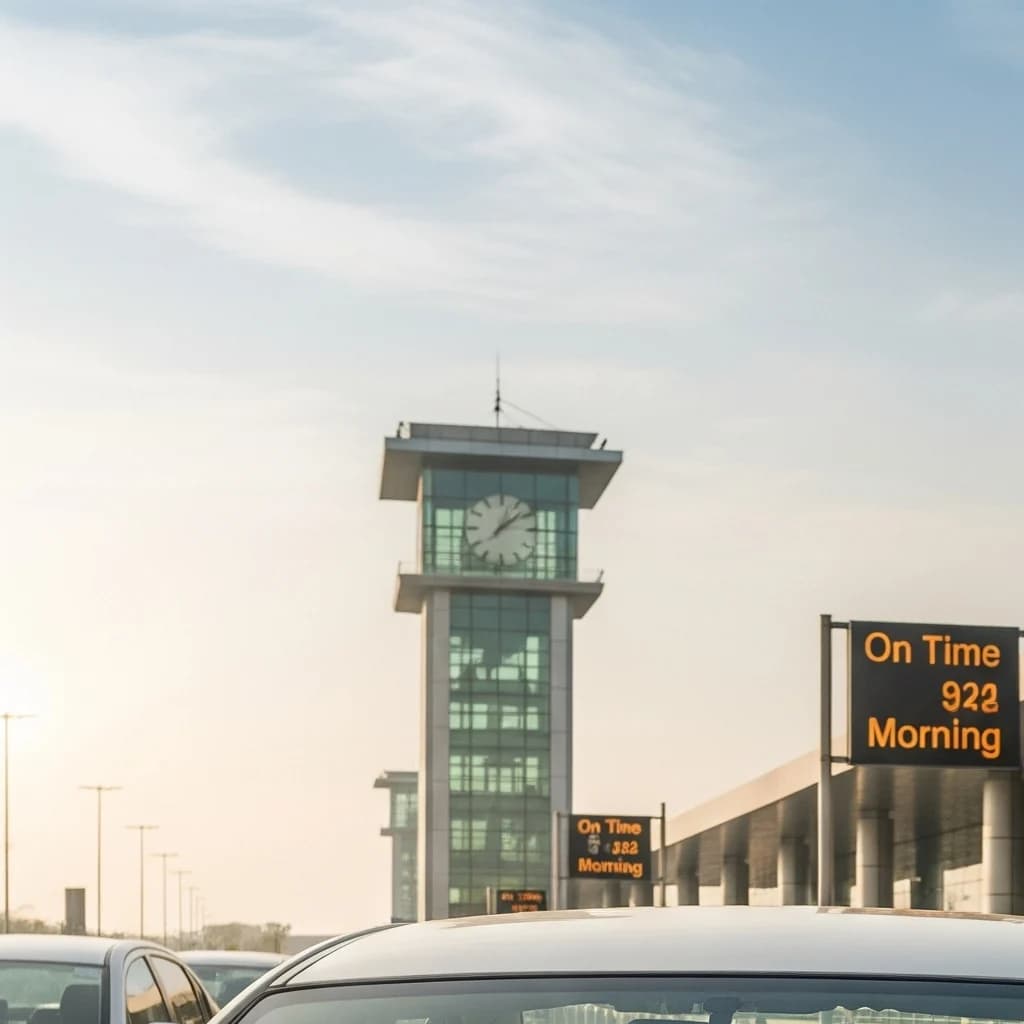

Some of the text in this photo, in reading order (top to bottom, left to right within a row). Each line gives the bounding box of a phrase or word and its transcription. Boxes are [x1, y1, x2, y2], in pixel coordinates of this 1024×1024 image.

[864, 631, 1001, 668] On Time
[868, 717, 1001, 759] Morning
[577, 818, 601, 835] On
